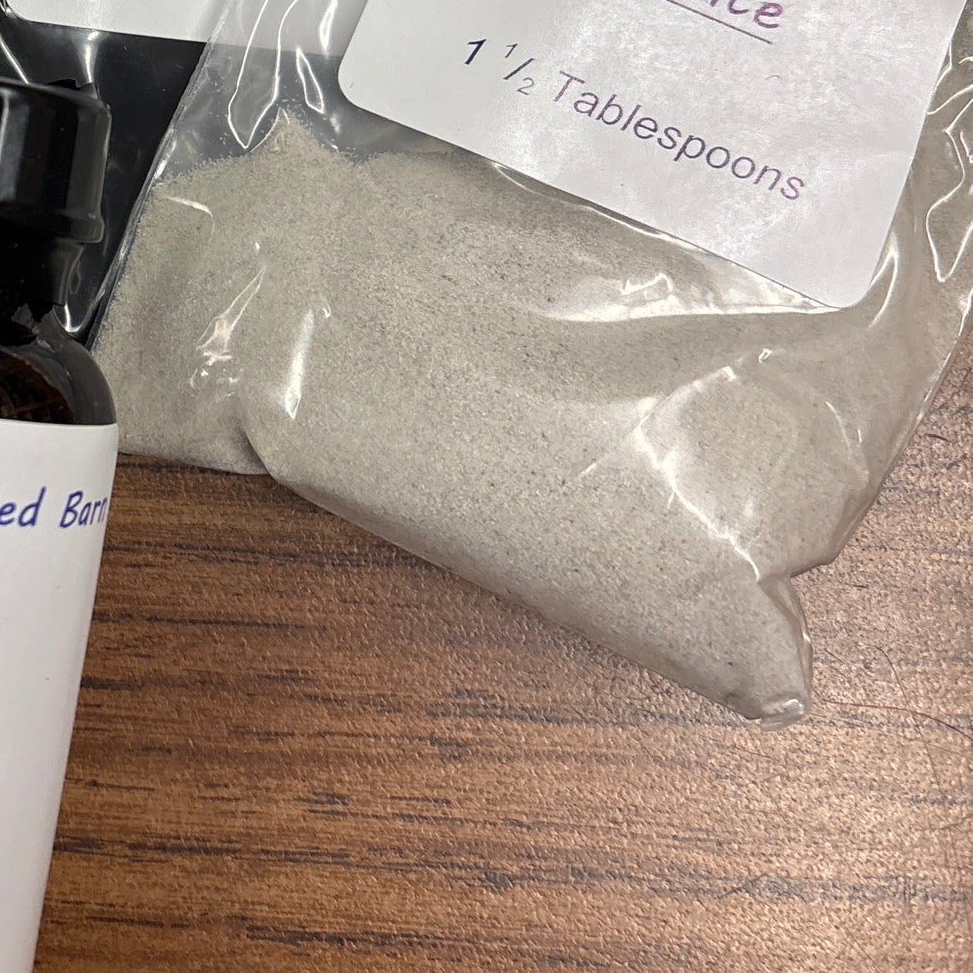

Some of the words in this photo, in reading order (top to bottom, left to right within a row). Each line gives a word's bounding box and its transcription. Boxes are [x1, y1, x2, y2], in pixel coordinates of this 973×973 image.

[464, 38, 487, 65] 1
[551, 69, 806, 201] Tablespoons
[59, 489, 108, 528] Barn
